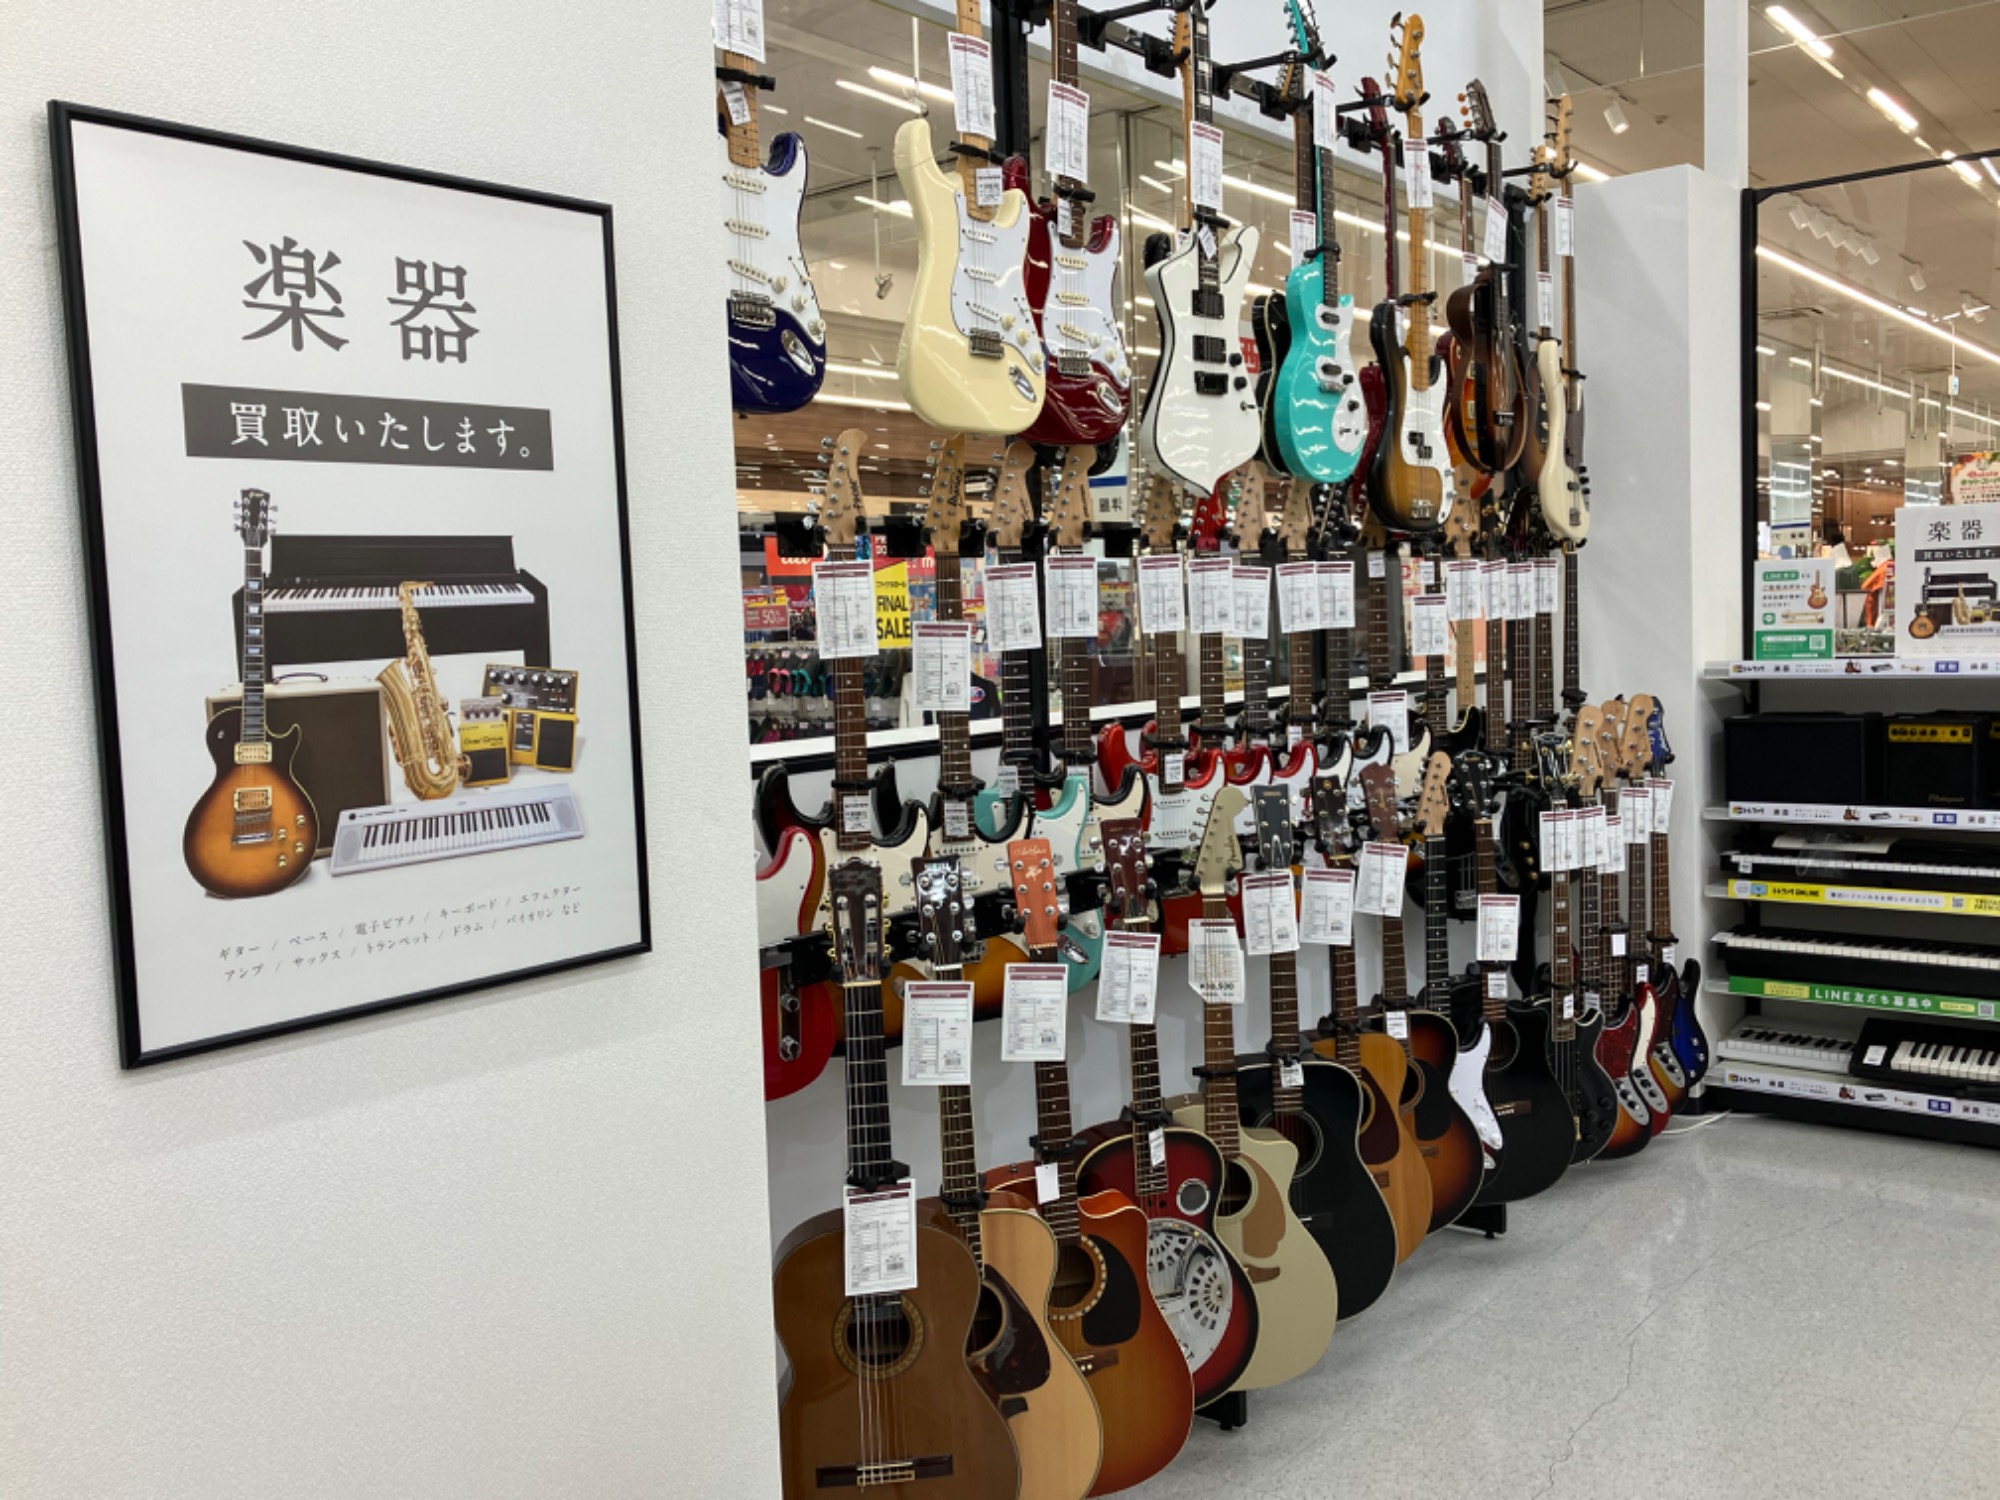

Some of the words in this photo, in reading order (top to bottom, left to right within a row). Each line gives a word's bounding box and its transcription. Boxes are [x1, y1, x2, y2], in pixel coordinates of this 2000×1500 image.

[242, 236, 479, 364] 楽器
[229, 402, 530, 458] 買取いたします。
[1927, 519, 1983, 542] 楽器
[877, 595, 908, 612] FINAL
[876, 617, 911, 640] SALE
